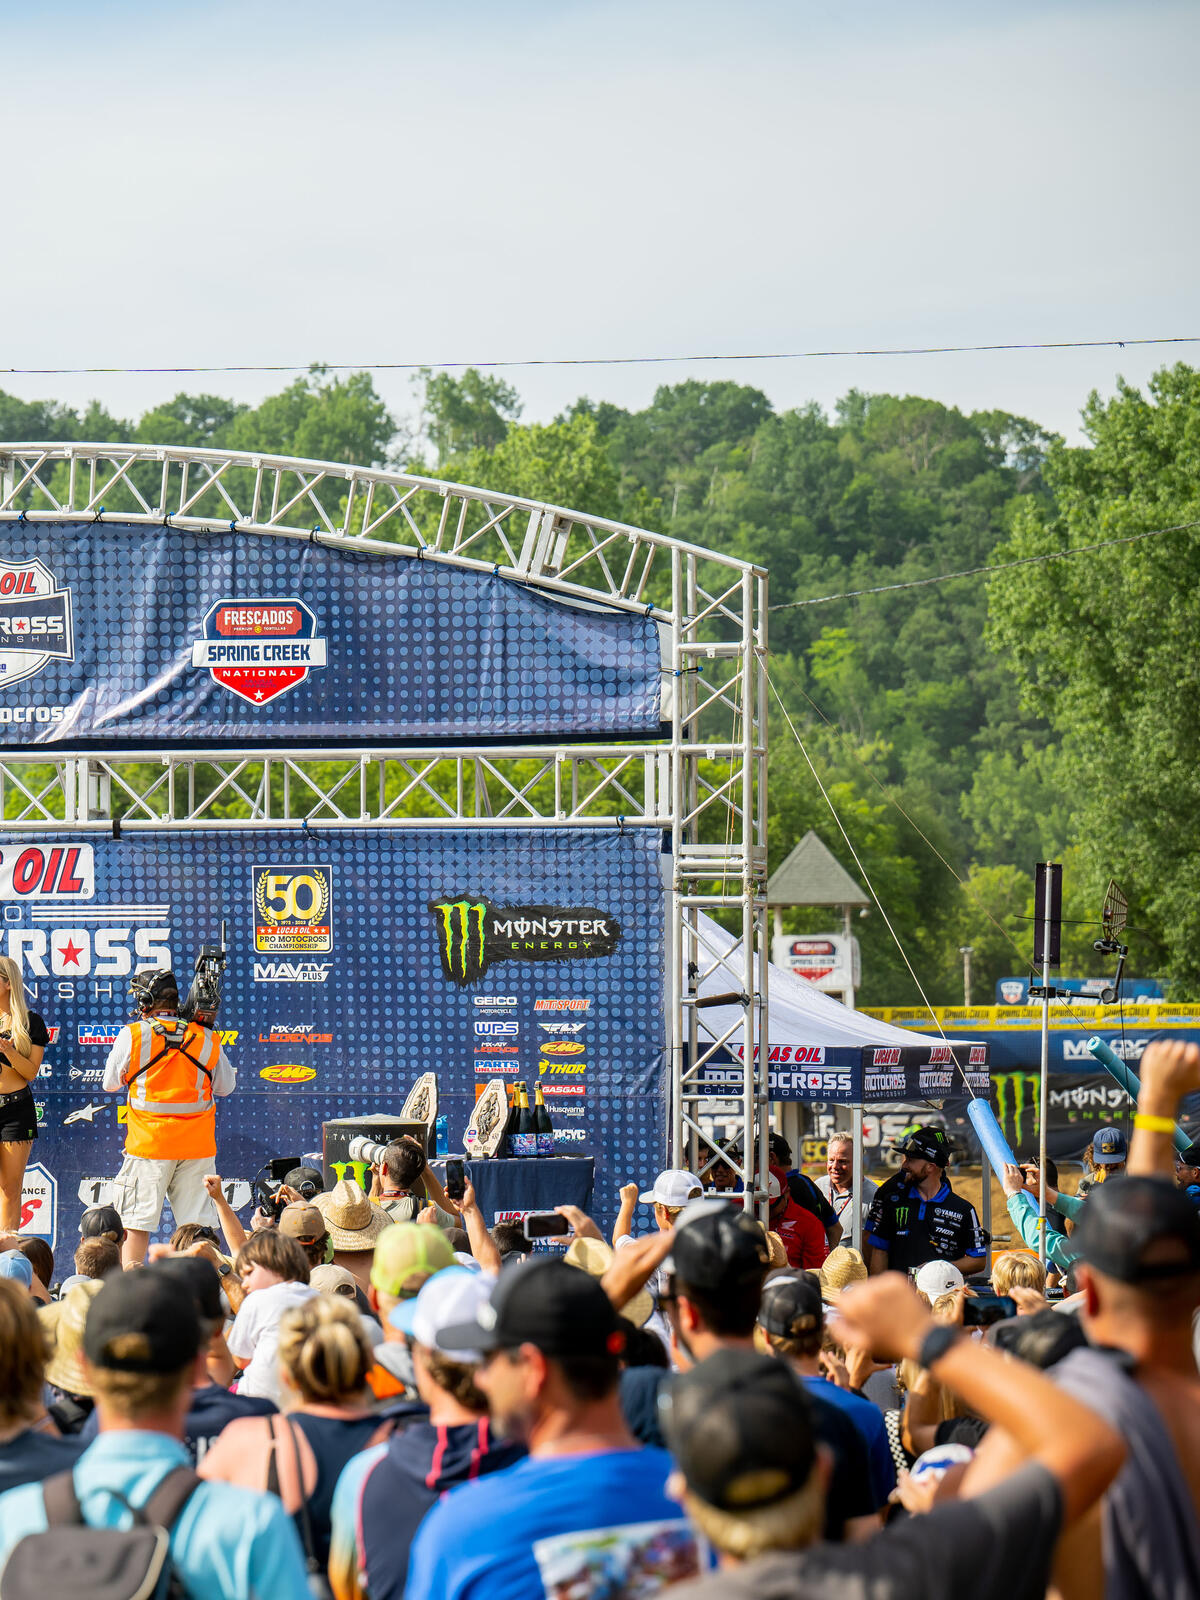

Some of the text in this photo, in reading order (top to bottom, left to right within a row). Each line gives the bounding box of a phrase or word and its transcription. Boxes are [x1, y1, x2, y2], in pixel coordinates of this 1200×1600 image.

[0, 572, 37, 595] OIL
[224, 610, 294, 626] FRESCADOS
[207, 644, 311, 662] SPRING CREEK
[222, 669, 297, 677] NATIONAL
[12, 847, 84, 894] OIL
[265, 875, 323, 920] 50
[493, 917, 610, 939] MONSTER
[278, 935, 328, 943] MOTOCROSS
[511, 941, 592, 950] ENERGY
[302, 972, 322, 980] PLUS
[474, 996, 518, 1006] GEICO
[270, 1025, 314, 1033] MX-ATV
[474, 1021, 519, 1036] WPS
[538, 1023, 587, 1032] FLY
[258, 1033, 333, 1044] LEGENDS
[795, 1047, 822, 1063] OIL
[874, 1048, 891, 1064] LUCAS
[475, 1060, 518, 1068] PARTS
[549, 1064, 586, 1074] THOR
[259, 1066, 317, 1080] FMF
[919, 1072, 953, 1088] MOTOCROSS
[865, 1074, 906, 1091] MOTOCROSS
[548, 1105, 585, 1114] Husqvarna
